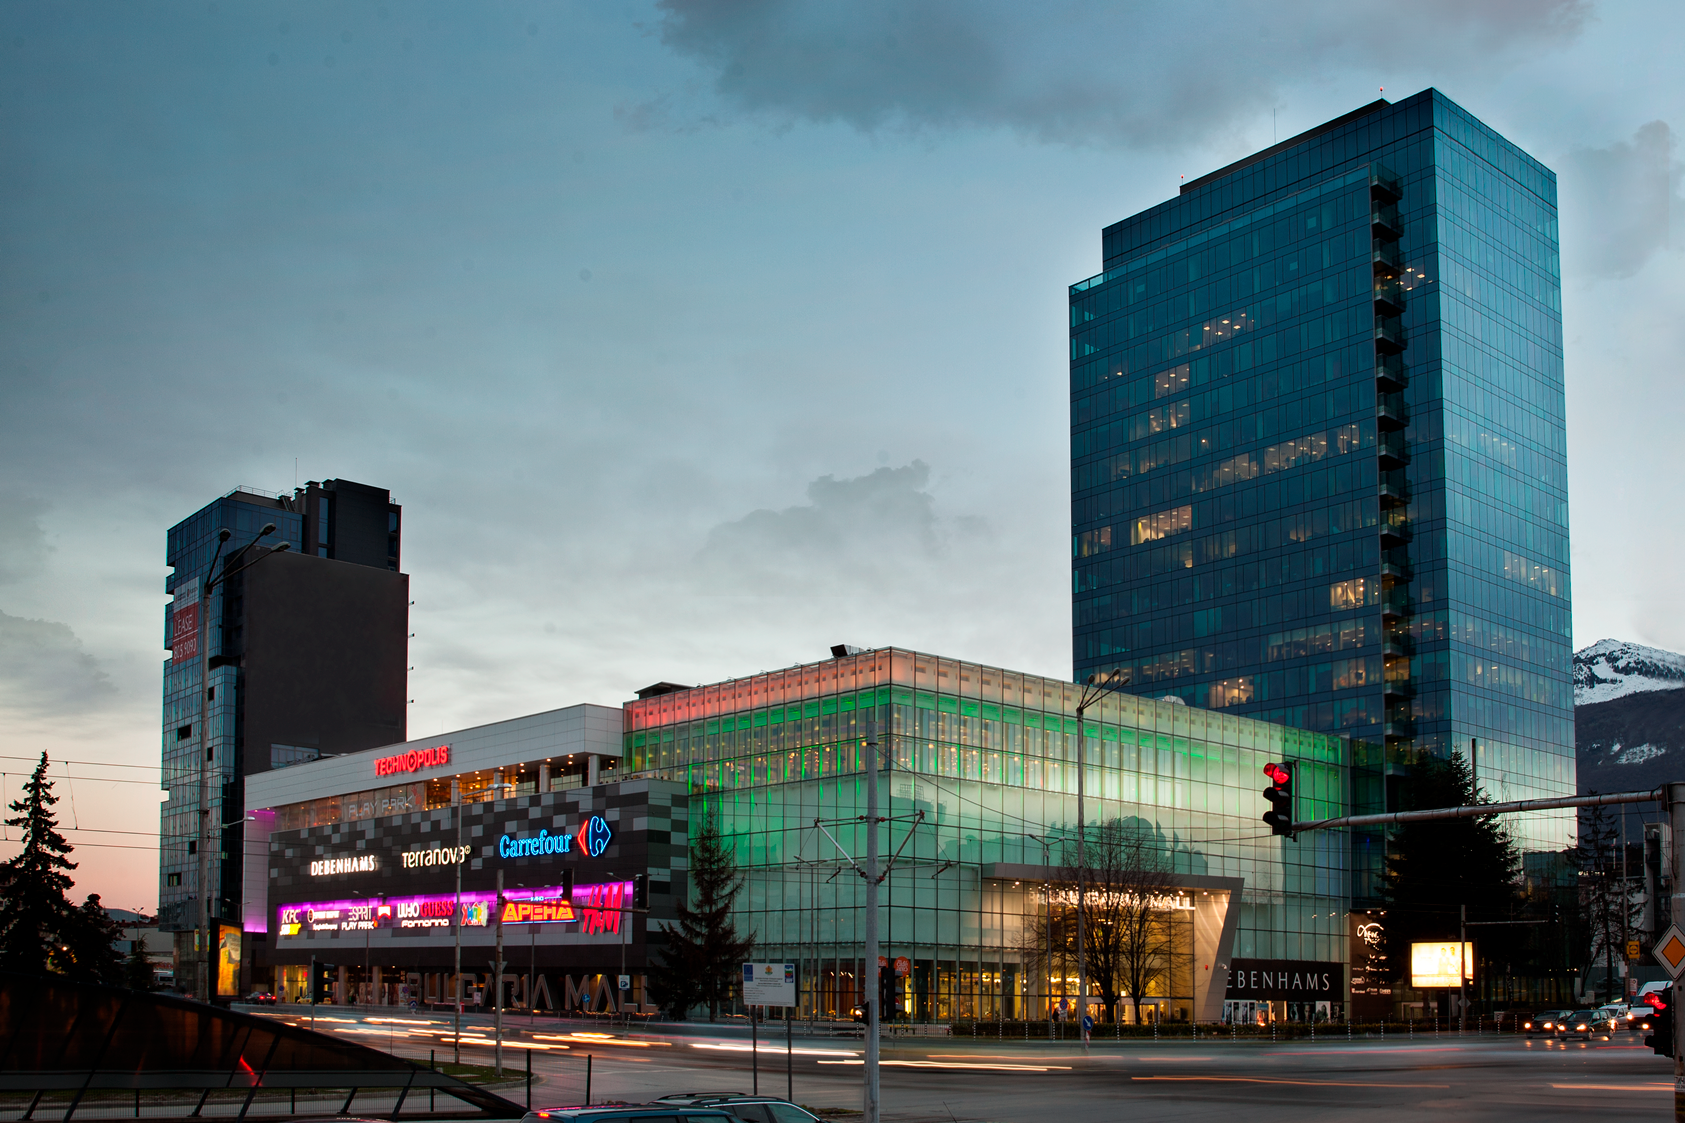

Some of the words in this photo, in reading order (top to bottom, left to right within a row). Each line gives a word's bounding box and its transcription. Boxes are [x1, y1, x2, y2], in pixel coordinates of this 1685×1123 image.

[174, 614, 193, 637] LEASE
[374, 746, 448, 776] TECHNOPOLIS
[349, 801, 378, 818] PLAY
[381, 795, 413, 813] PARK
[500, 828, 573, 859] Carrefour
[310, 854, 375, 877] DEBENHAMS
[282, 908, 301, 924] KFC
[348, 905, 373, 921] ESPRIT
[420, 901, 454, 918] GUESS
[406, 971, 553, 1010] BULGARIA
[565, 973, 660, 1014] MALL
